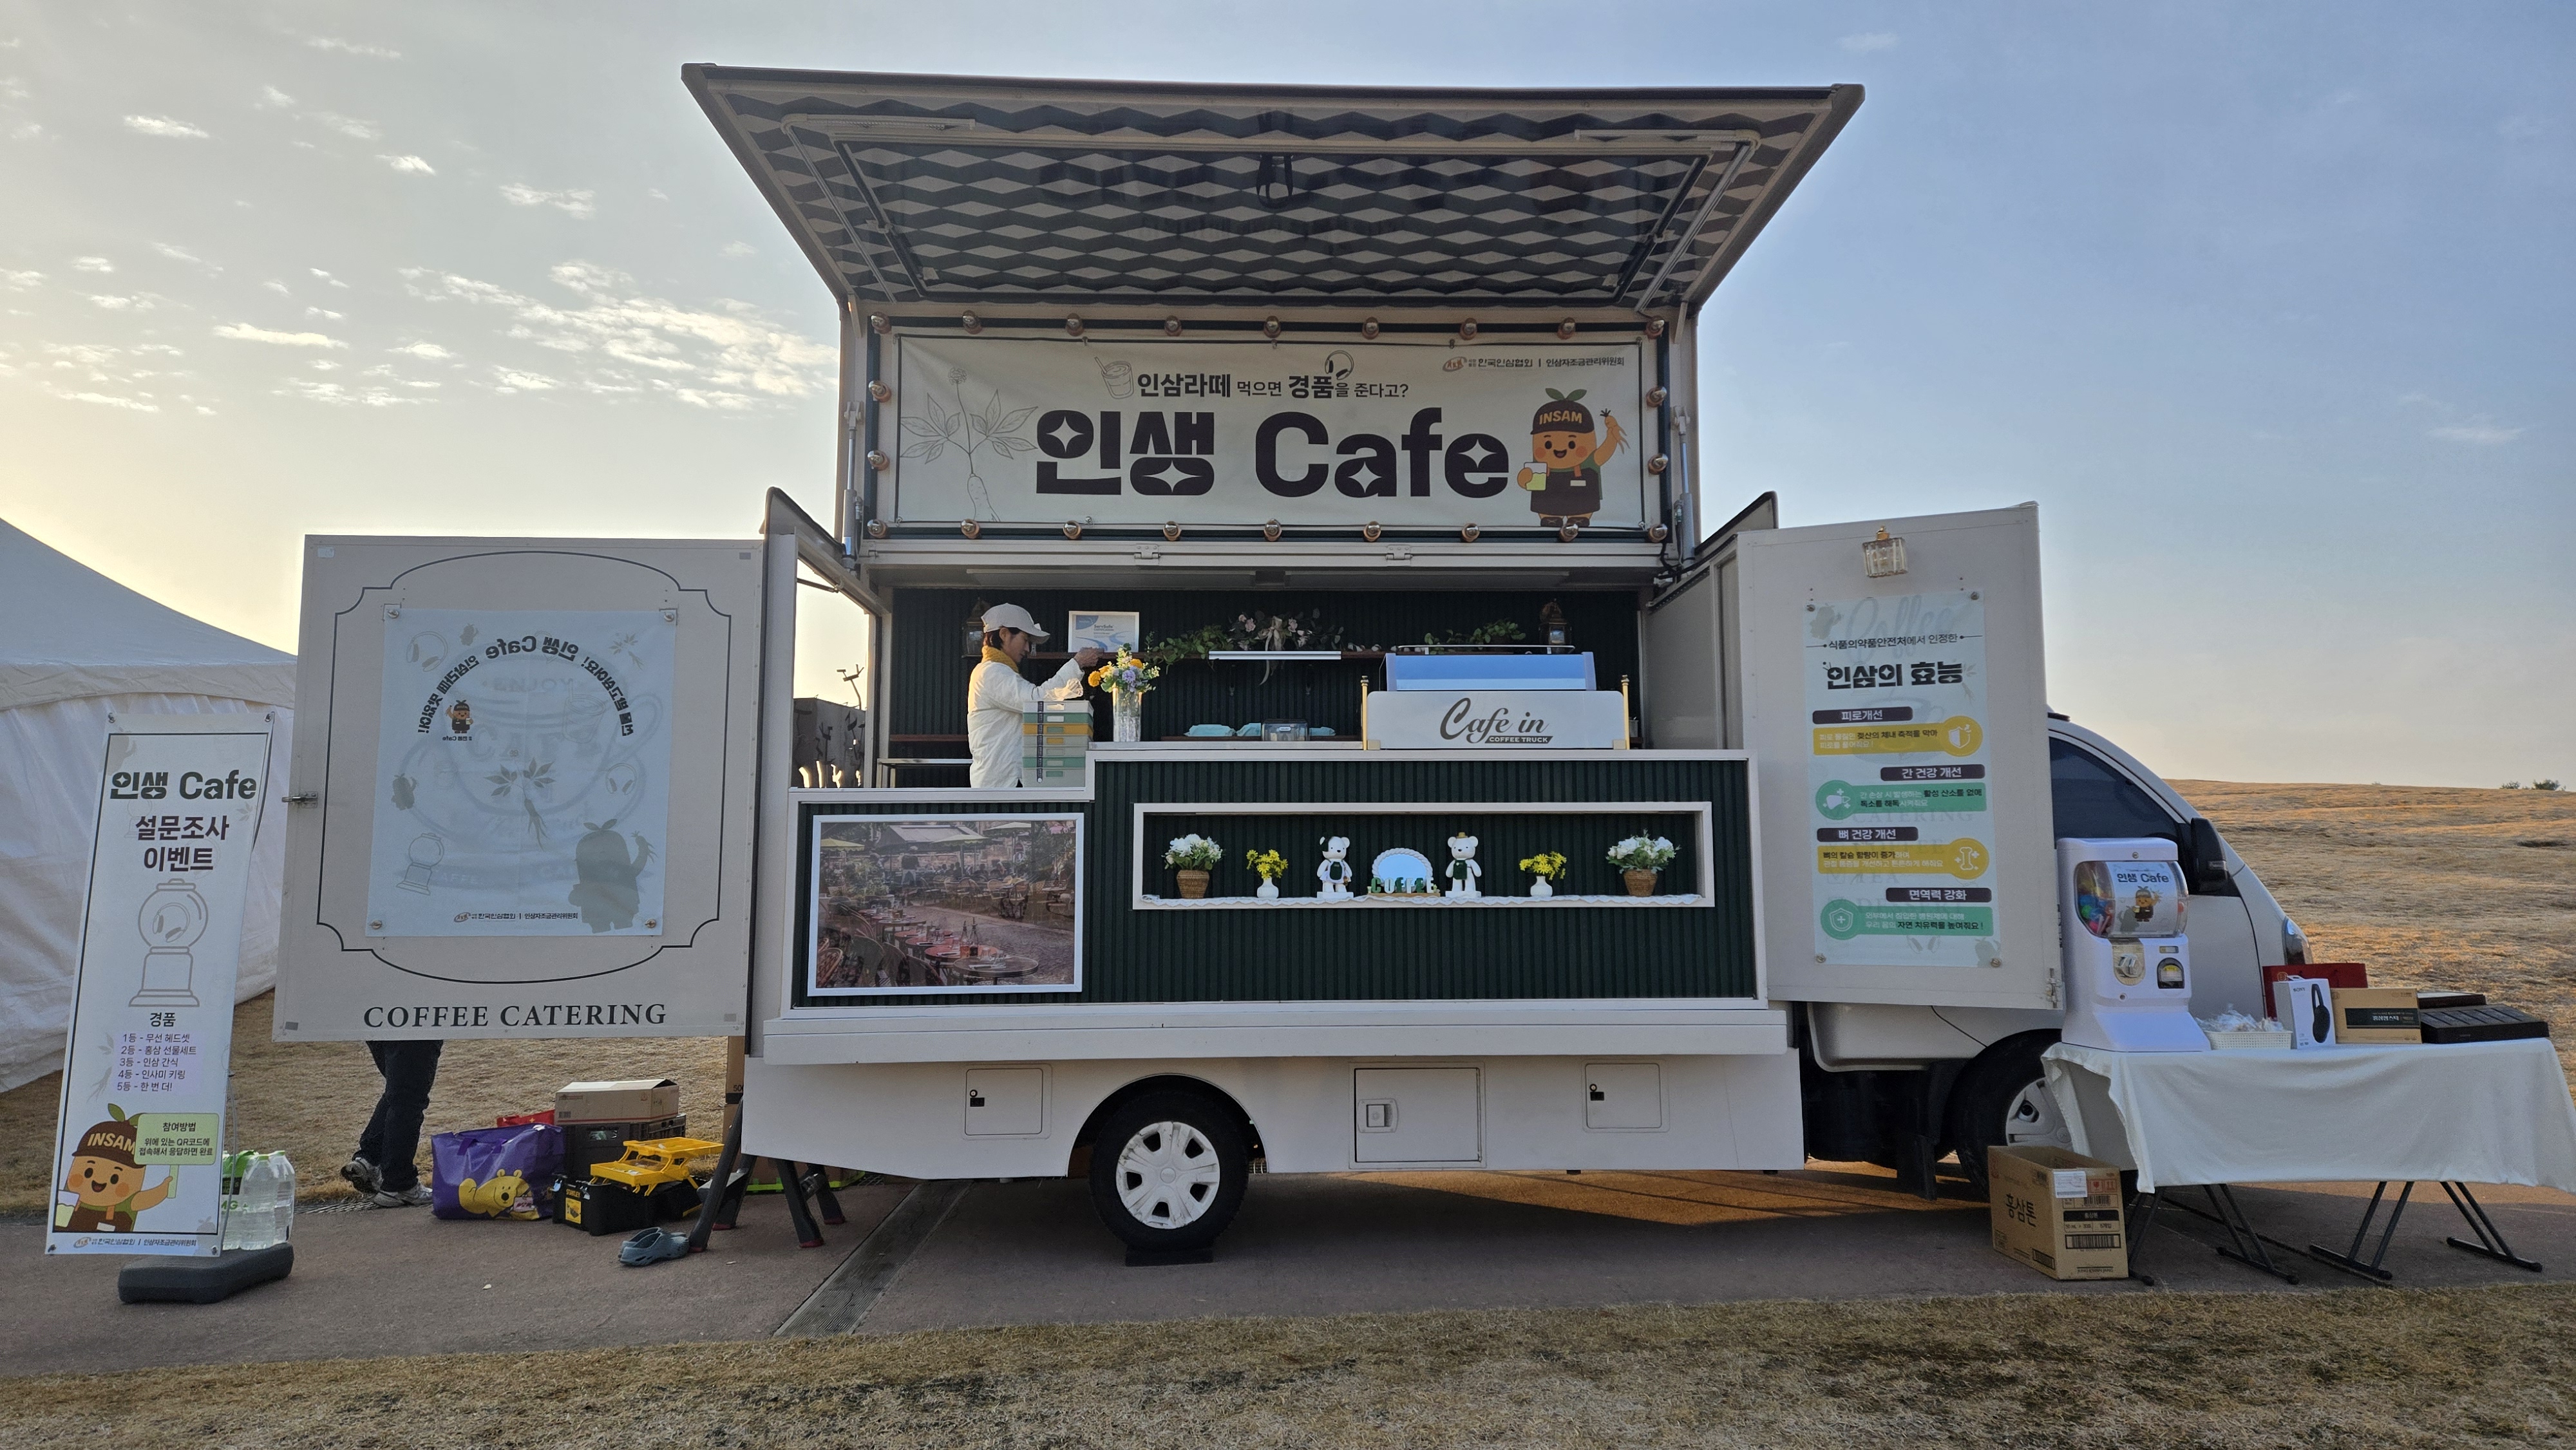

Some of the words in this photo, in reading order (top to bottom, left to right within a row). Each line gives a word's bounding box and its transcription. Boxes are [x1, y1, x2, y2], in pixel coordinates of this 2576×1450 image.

[1478, 358, 1533, 368] 한국인삼협회
[1546, 357, 1625, 367] 인삼자조금관리위원회
[1137, 373, 1231, 398] 인삼라떼
[1237, 381, 1282, 397] 먹으면
[1288, 375, 1350, 399] 경품을
[1354, 383, 1408, 399] 준다고?
[1539, 410, 1583, 425] INSAM
[1036, 410, 1215, 496] 인생
[1255, 407, 1509, 498] Cafe
[1828, 636, 1926, 650] 식품의약품안전처에서
[1927, 634, 1958, 645] 인정한
[1827, 663, 1904, 690] 인삼의
[1910, 661, 1964, 686] 효능
[1440, 697, 1513, 744] Cafe
[1518, 711, 1550, 733] in
[1841, 710, 1883, 721] 피로개선
[1902, 768, 1913, 778] 간
[1915, 767, 1938, 778] 건강
[1940, 767, 1962, 778] 개선
[110, 771, 169, 800] 인생
[179, 769, 257, 800] Cafe
[135, 814, 229, 841] 설문조사
[1838, 829, 1849, 840] 뼈
[1852, 829, 1873, 840] 건강
[1875, 829, 1897, 839] 개선
[144, 846, 214, 872] 이벤트
[2140, 872, 2170, 883] Cafe
[1370, 876, 1435, 894] COFFEE
[1909, 889, 1942, 900] 면역력
[1944, 889, 1967, 901] 강화
[1915, 921, 1945, 930] 치유력을
[149, 1012, 176, 1027] 경품
[363, 1006, 489, 1028] COFFEE
[500, 1003, 667, 1027] CATERING
[123, 1033, 137, 1043] 1등
[146, 1033, 162, 1043] 무선
[164, 1033, 190, 1043] 헤드셋
[121, 1045, 135, 1055] 2등
[144, 1045, 162, 1055] 홍삼
[164, 1046, 197, 1055] 선물세트
[119, 1057, 134, 1067] 3등
[143, 1057, 160, 1067] 인삼
[162, 1057, 178, 1067] 간식
[118, 1069, 133, 1079] 4등
[142, 1069, 167, 1079] 인사미
[169, 1069, 185, 1080] 키링
[117, 1082, 131, 1091] 5등
[140, 1082, 149, 1092] 한
[151, 1082, 159, 1091] 번
[162, 1082, 173, 1091] 더!
[162, 1122, 196, 1132] 참여방법
[87, 1133, 136, 1155] INSAM
[144, 1138, 159, 1146] 위에
[161, 1138, 175, 1147] 있는
[176, 1138, 210, 1146] QR코드에
[139, 1147, 167, 1156] 접속해서
[169, 1147, 198, 1156] 응답하면
[199, 1147, 213, 1156] 완료
[2005, 1192, 2037, 1228] 홍삼톤
